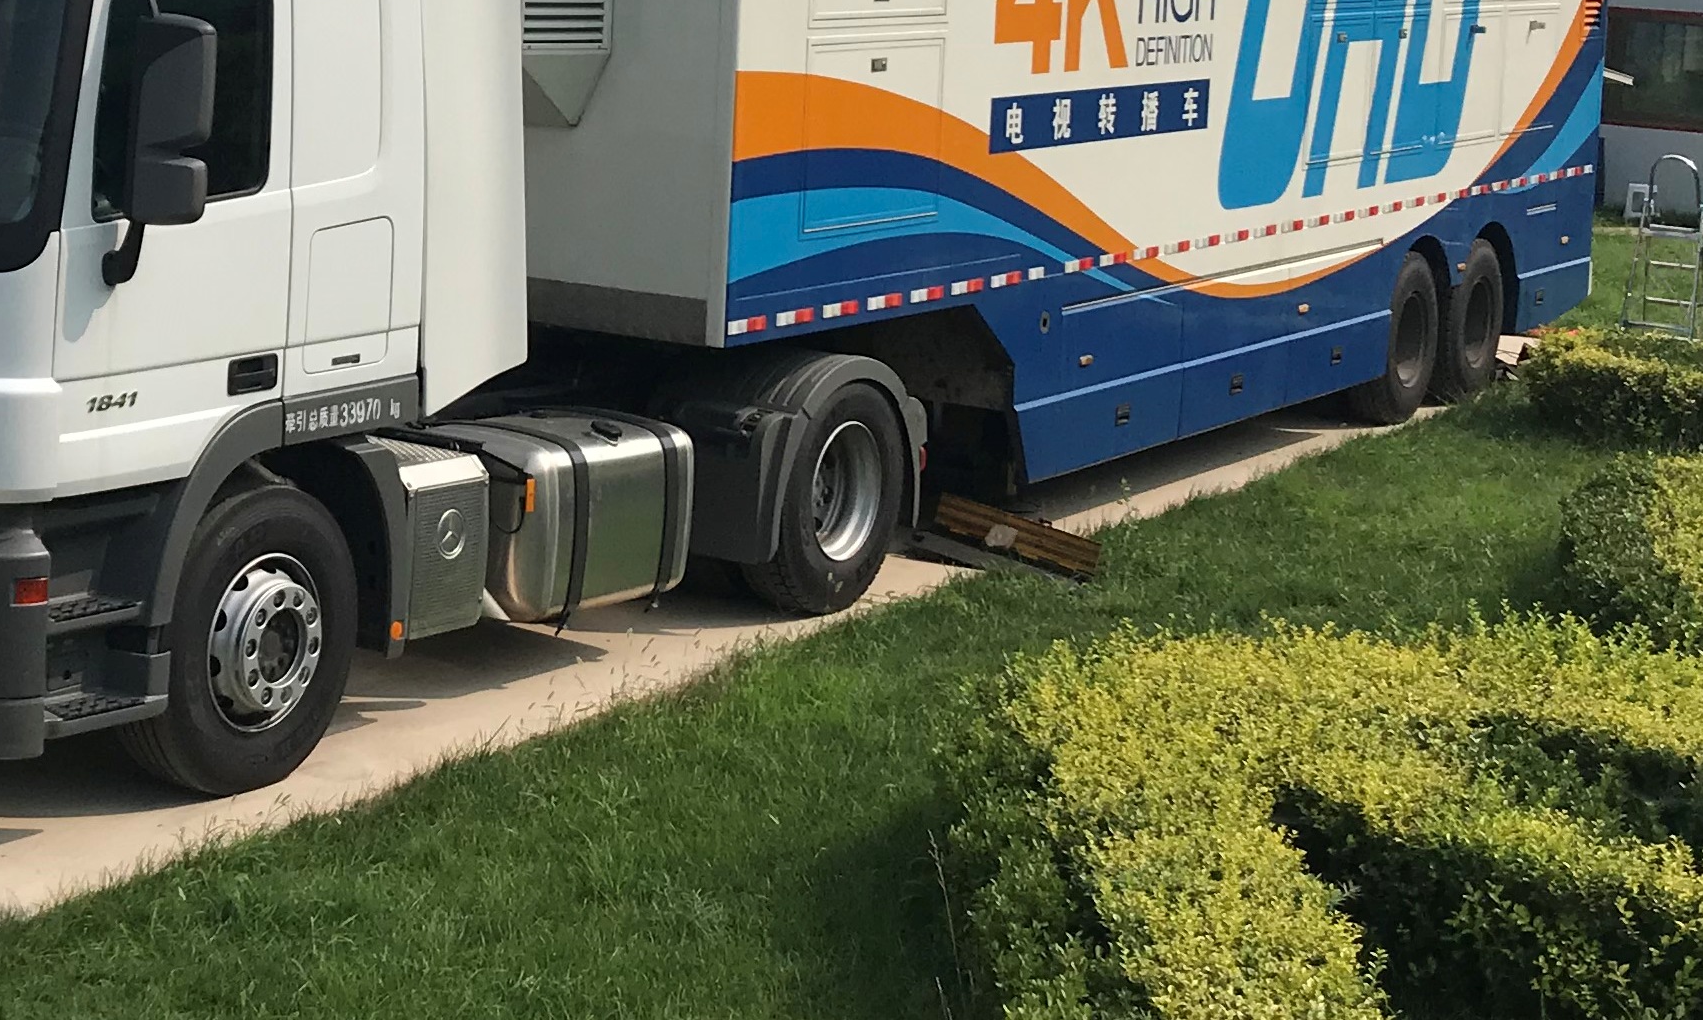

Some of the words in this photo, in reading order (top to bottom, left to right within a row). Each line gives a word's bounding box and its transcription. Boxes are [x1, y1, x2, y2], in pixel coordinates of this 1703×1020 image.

[1135, 33, 1213, 67] DEFINITION
[1005, 87, 1199, 144] 电视转播车
[86, 390, 138, 413] 1841
